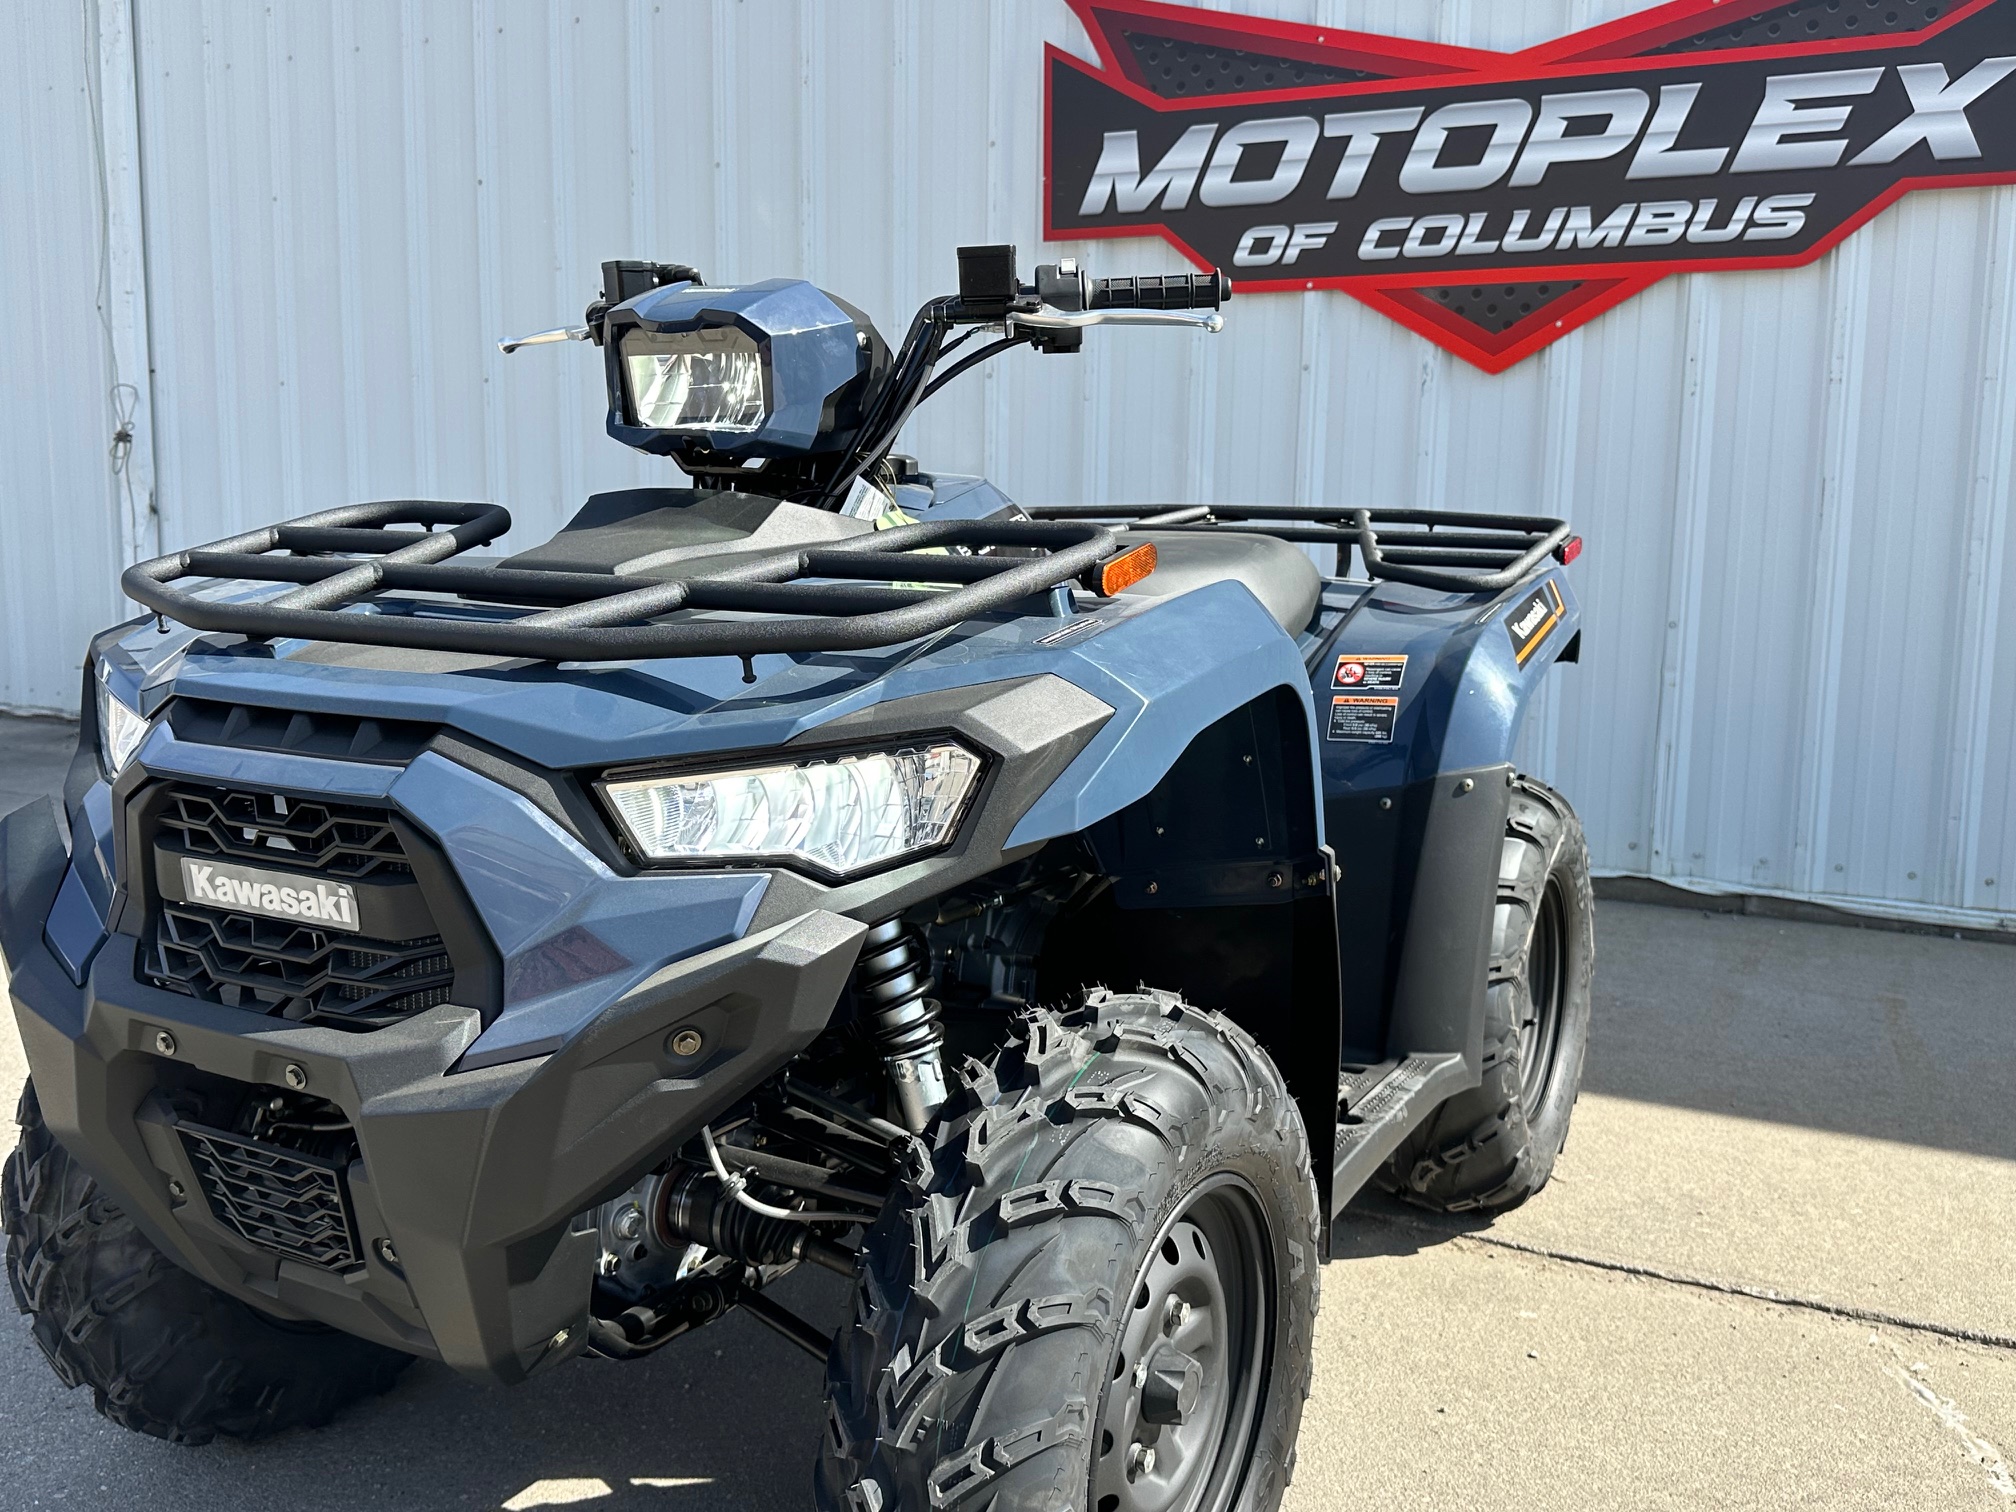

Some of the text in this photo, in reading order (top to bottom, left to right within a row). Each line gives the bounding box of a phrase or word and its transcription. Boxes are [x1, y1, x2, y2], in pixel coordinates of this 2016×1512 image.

[1079, 56, 2016, 216] MOTOPLEX
[1233, 193, 1816, 267] OF COLUMBUS
[1511, 598, 1548, 640] Kawasaki
[189, 864, 351, 923] Kawasaki
